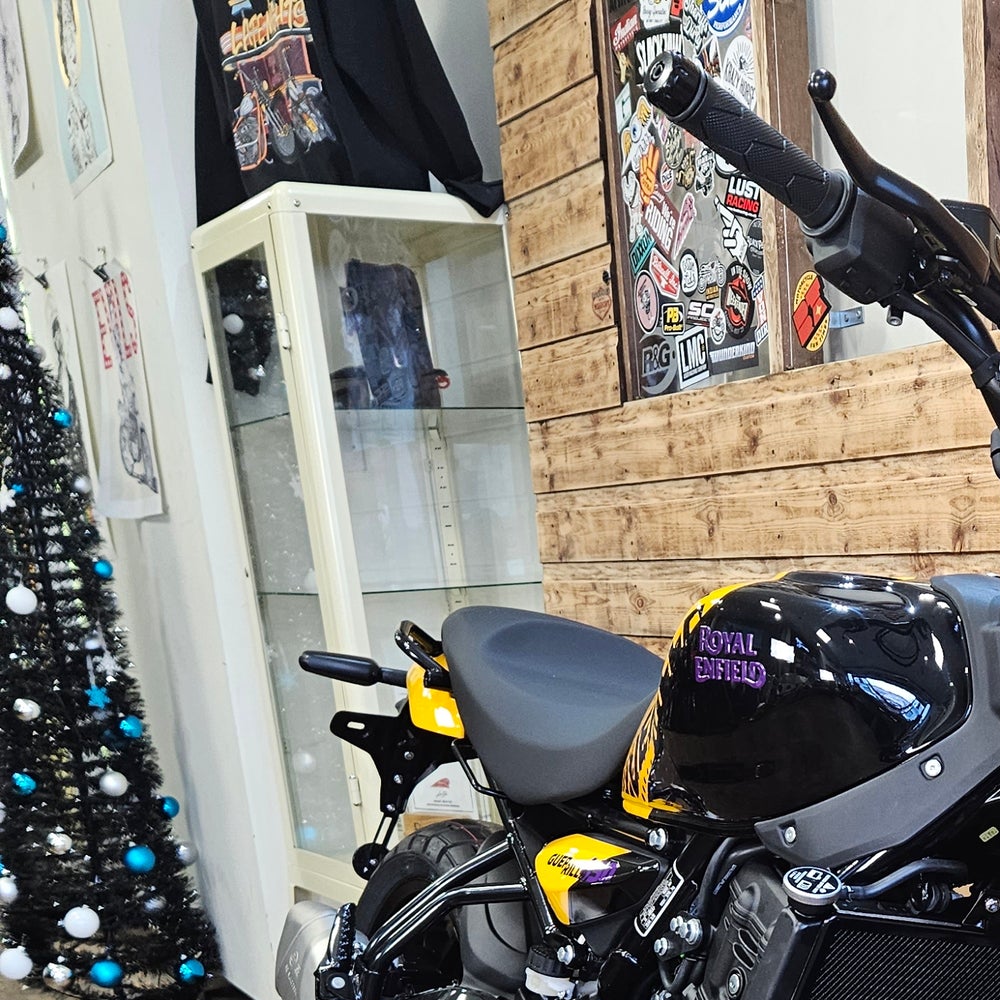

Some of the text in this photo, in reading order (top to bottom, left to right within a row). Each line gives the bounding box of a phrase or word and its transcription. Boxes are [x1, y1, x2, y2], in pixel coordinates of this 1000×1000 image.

[729, 176, 761, 200] LUST
[726, 194, 760, 213] RACING
[666, 306, 680, 323] PB
[688, 301, 715, 318] SC
[642, 342, 671, 375] R&G
[680, 333, 706, 373] LMC
[699, 625, 757, 656] ROYAL
[695, 656, 767, 689] ENFIELD
